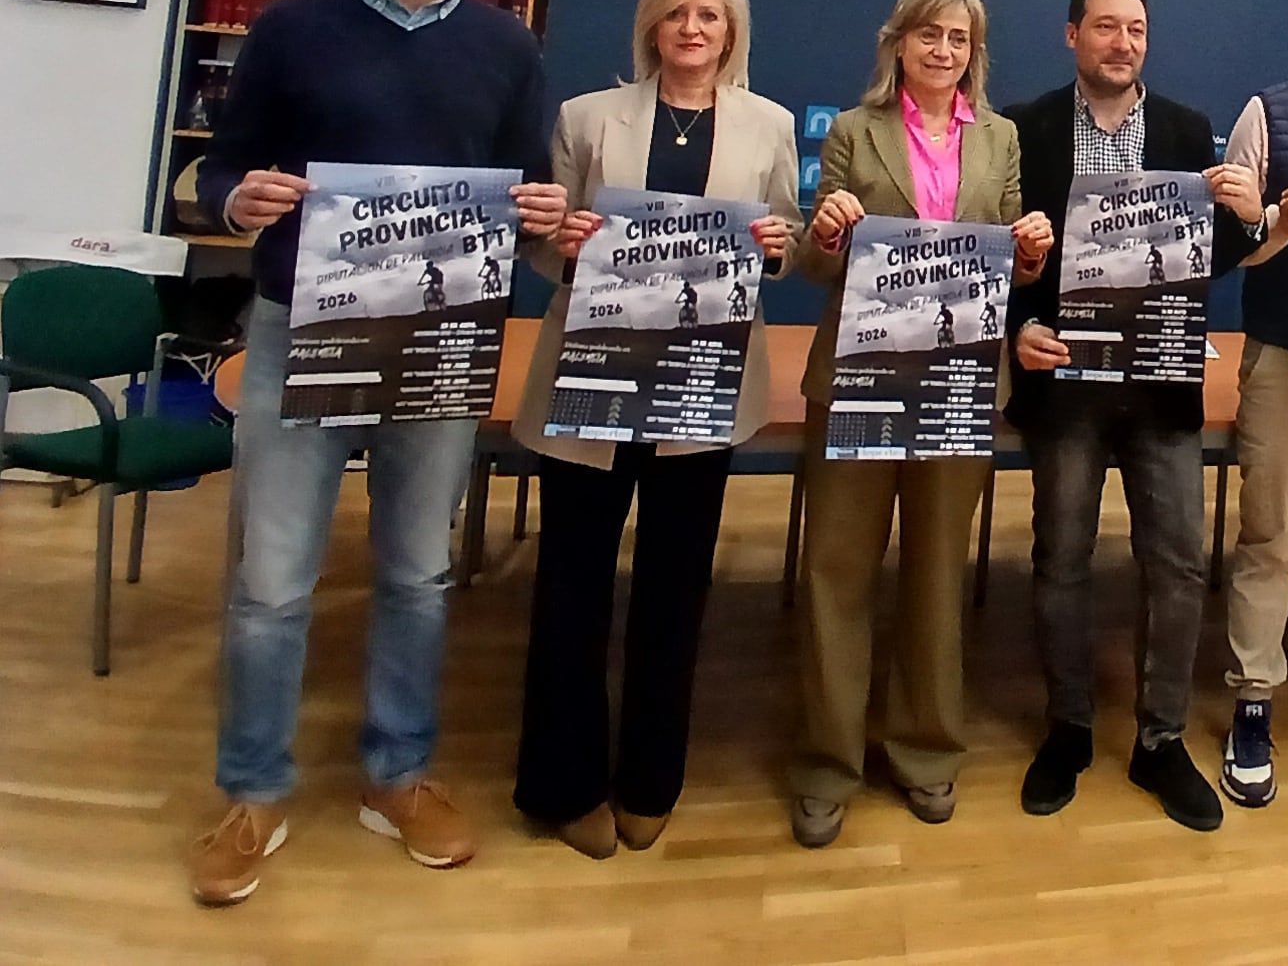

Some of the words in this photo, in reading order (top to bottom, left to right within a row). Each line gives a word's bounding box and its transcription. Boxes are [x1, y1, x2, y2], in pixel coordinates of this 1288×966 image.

[352, 180, 470, 221] CIRCUITO
[1099, 181, 1179, 213] CIRCUITO
[339, 204, 491, 253] PROVINCIAL
[626, 211, 726, 240] CIRCUITO
[1091, 201, 1194, 236] PROVINCIAL
[1174, 220, 1206, 240] BTT
[462, 228, 506, 254] BTT
[612, 234, 743, 267] PROVINCIAL
[887, 234, 977, 266] CIRCUITO
[716, 256, 755, 278] BTT
[876, 255, 992, 293] PROVINCIAL
[1076, 267, 1104, 281] 2026
[317, 292, 357, 310] 2026
[968, 277, 1003, 299] BTT
[589, 303, 623, 319] 2026
[857, 328, 887, 343] 2026
